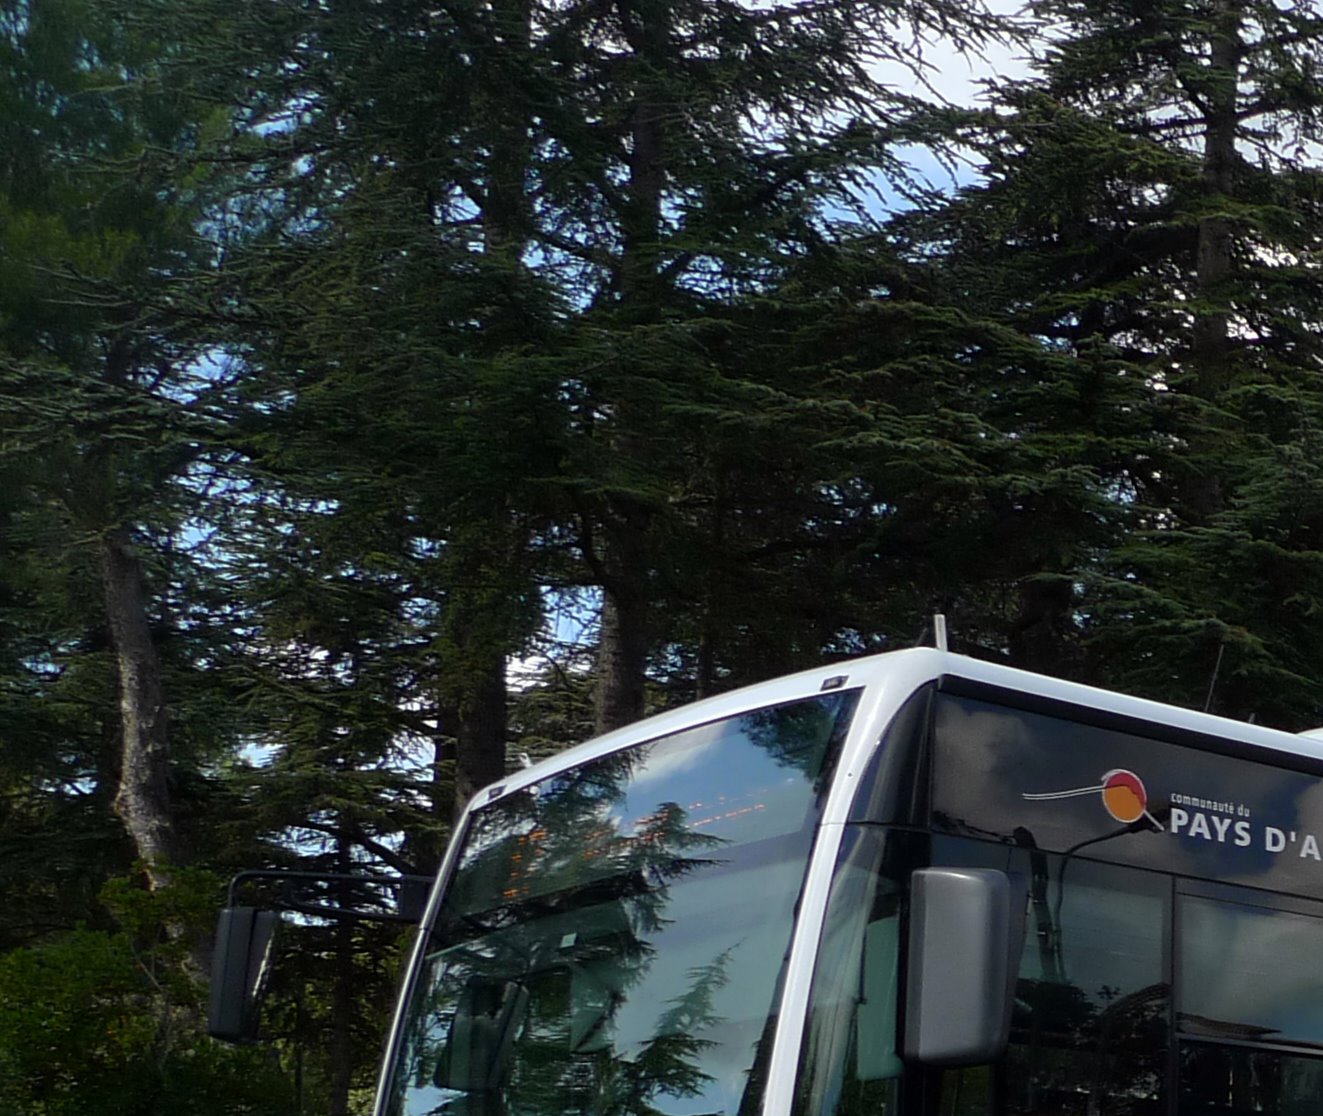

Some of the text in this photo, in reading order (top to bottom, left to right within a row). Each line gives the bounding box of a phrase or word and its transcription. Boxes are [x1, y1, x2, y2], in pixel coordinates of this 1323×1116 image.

[1171, 793, 1250, 817] communauté du
[1170, 808, 1251, 847] PAYS
